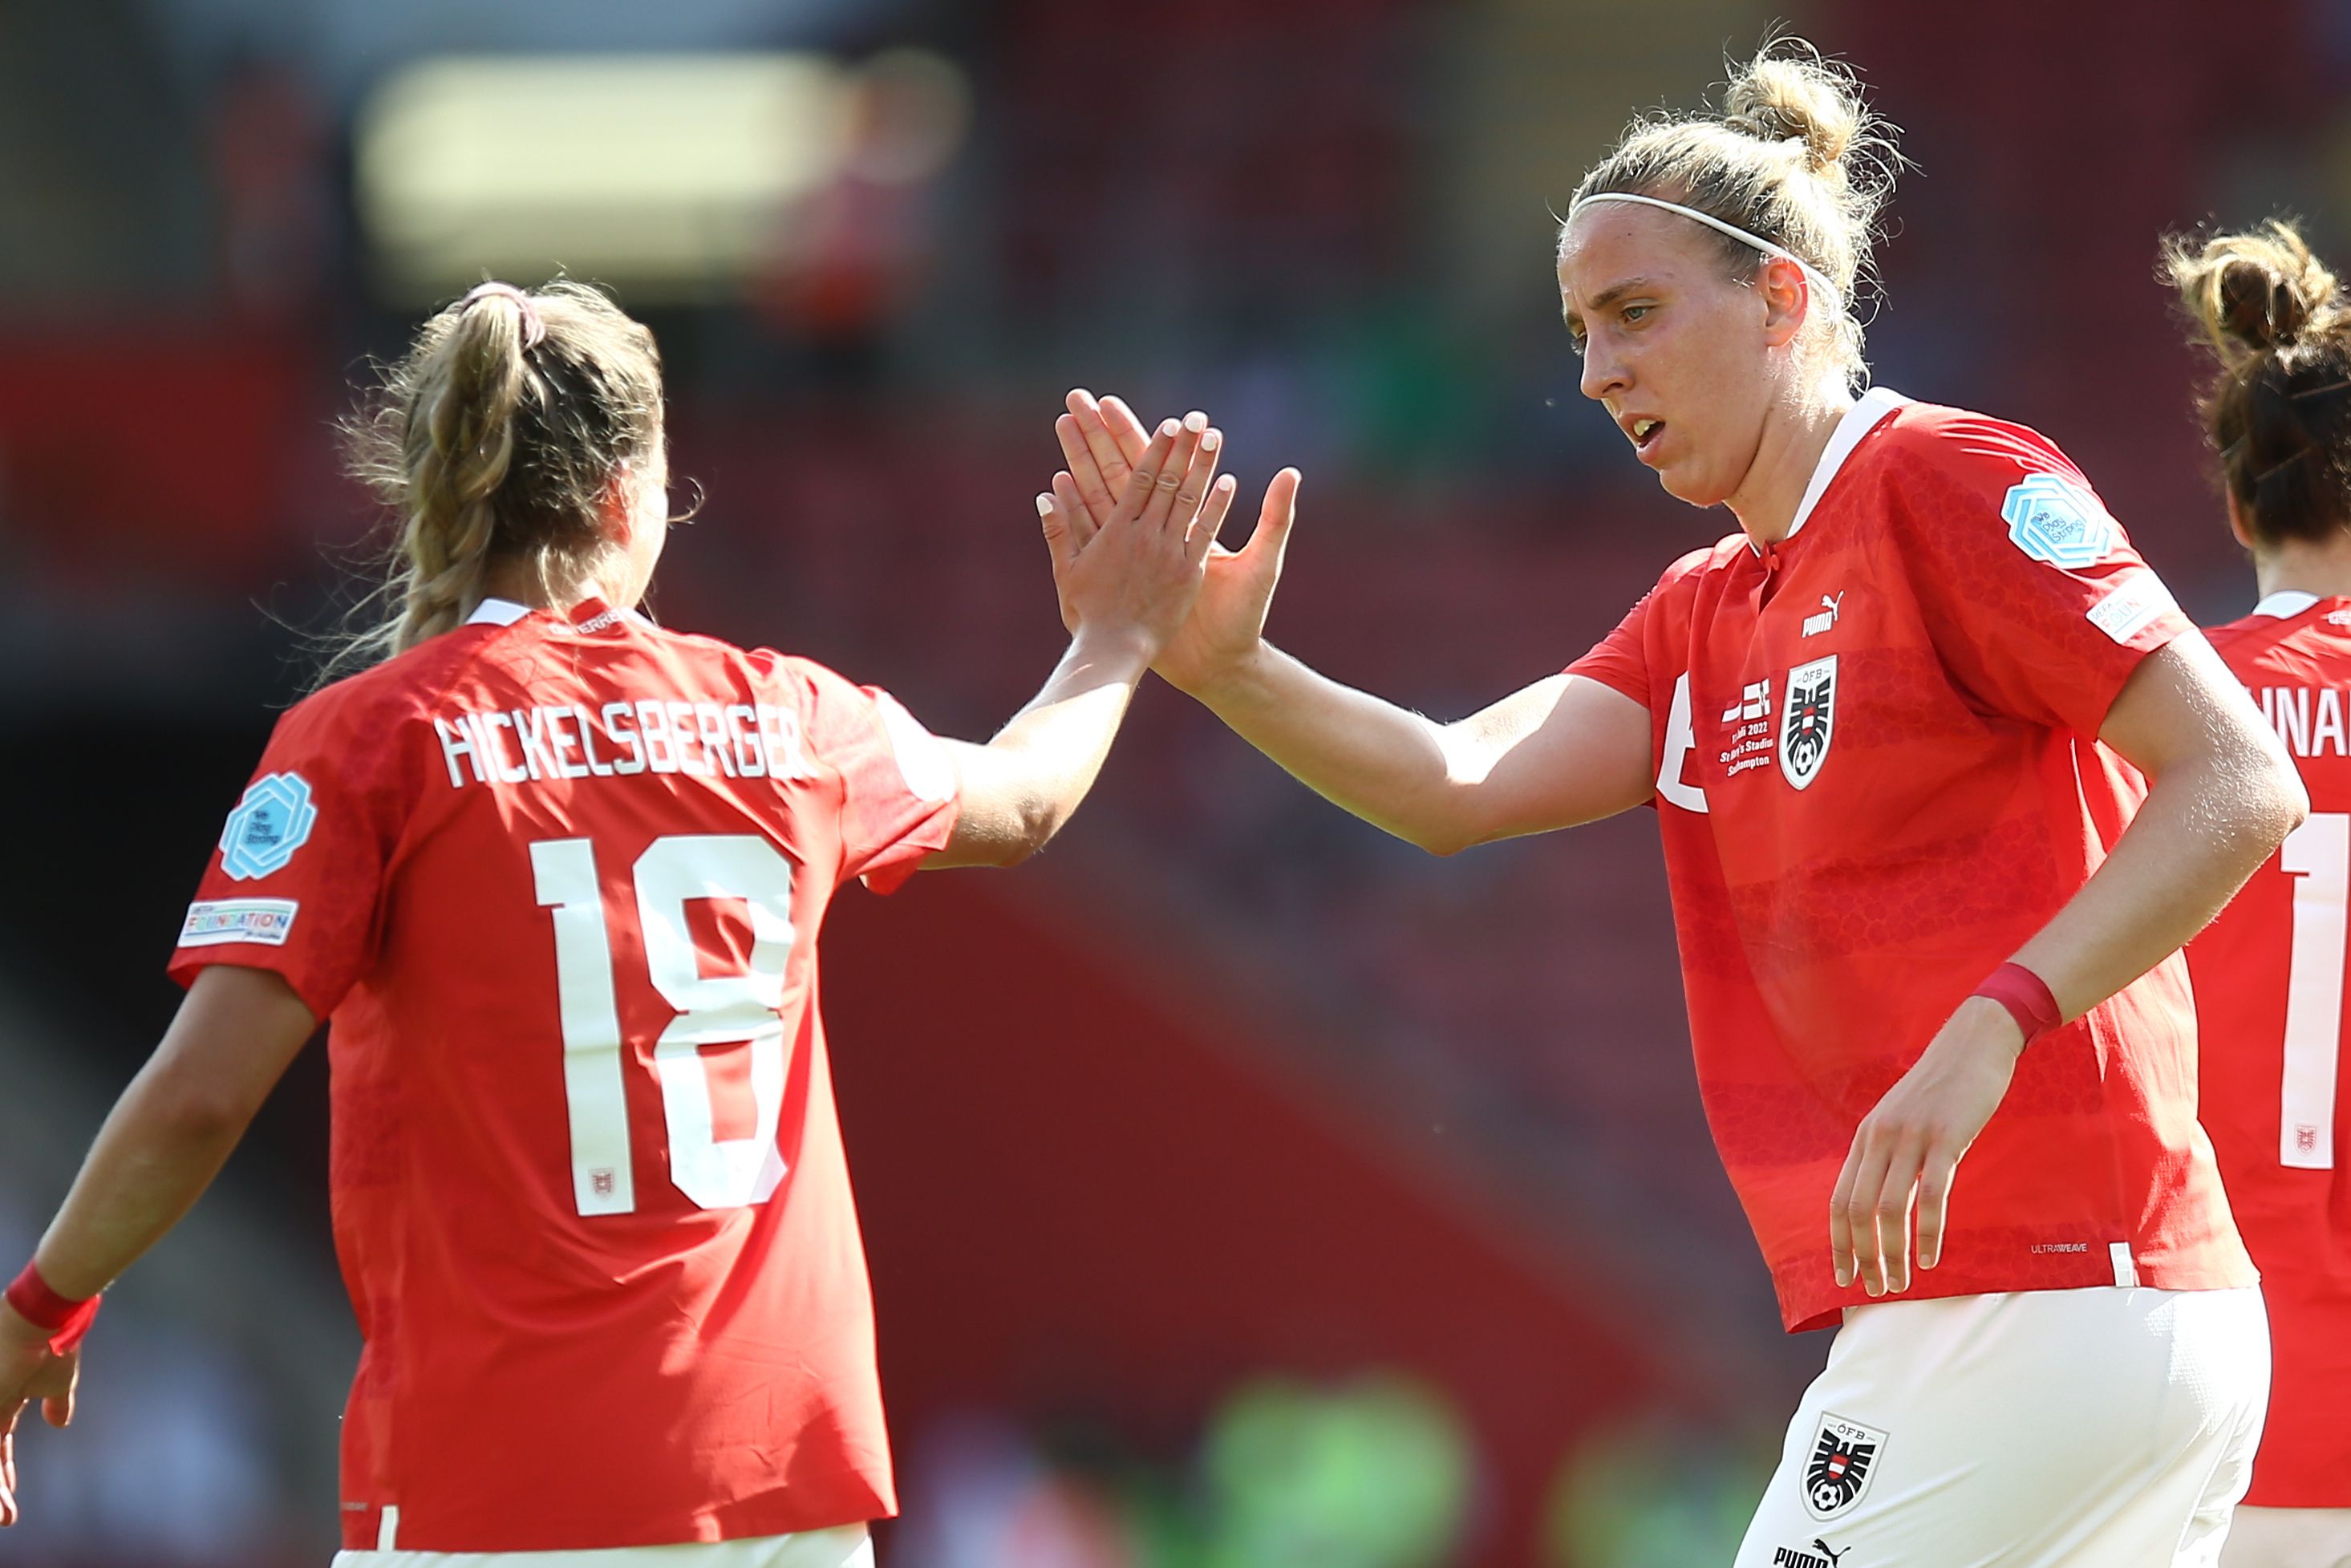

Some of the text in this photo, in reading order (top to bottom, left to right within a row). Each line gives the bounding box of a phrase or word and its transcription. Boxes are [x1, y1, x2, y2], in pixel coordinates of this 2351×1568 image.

[1802, 610, 1833, 638] PUMA
[1802, 668, 1822, 683] ÖFB
[1747, 721, 1768, 735] 2022
[433, 701, 819, 788] HICKELSBERGER
[1719, 752, 1730, 763] St
[528, 833, 796, 1217] 18
[2030, 1242, 2088, 1254] ULTRAWEAVE
[1837, 1423, 1866, 1440] ÖFB
